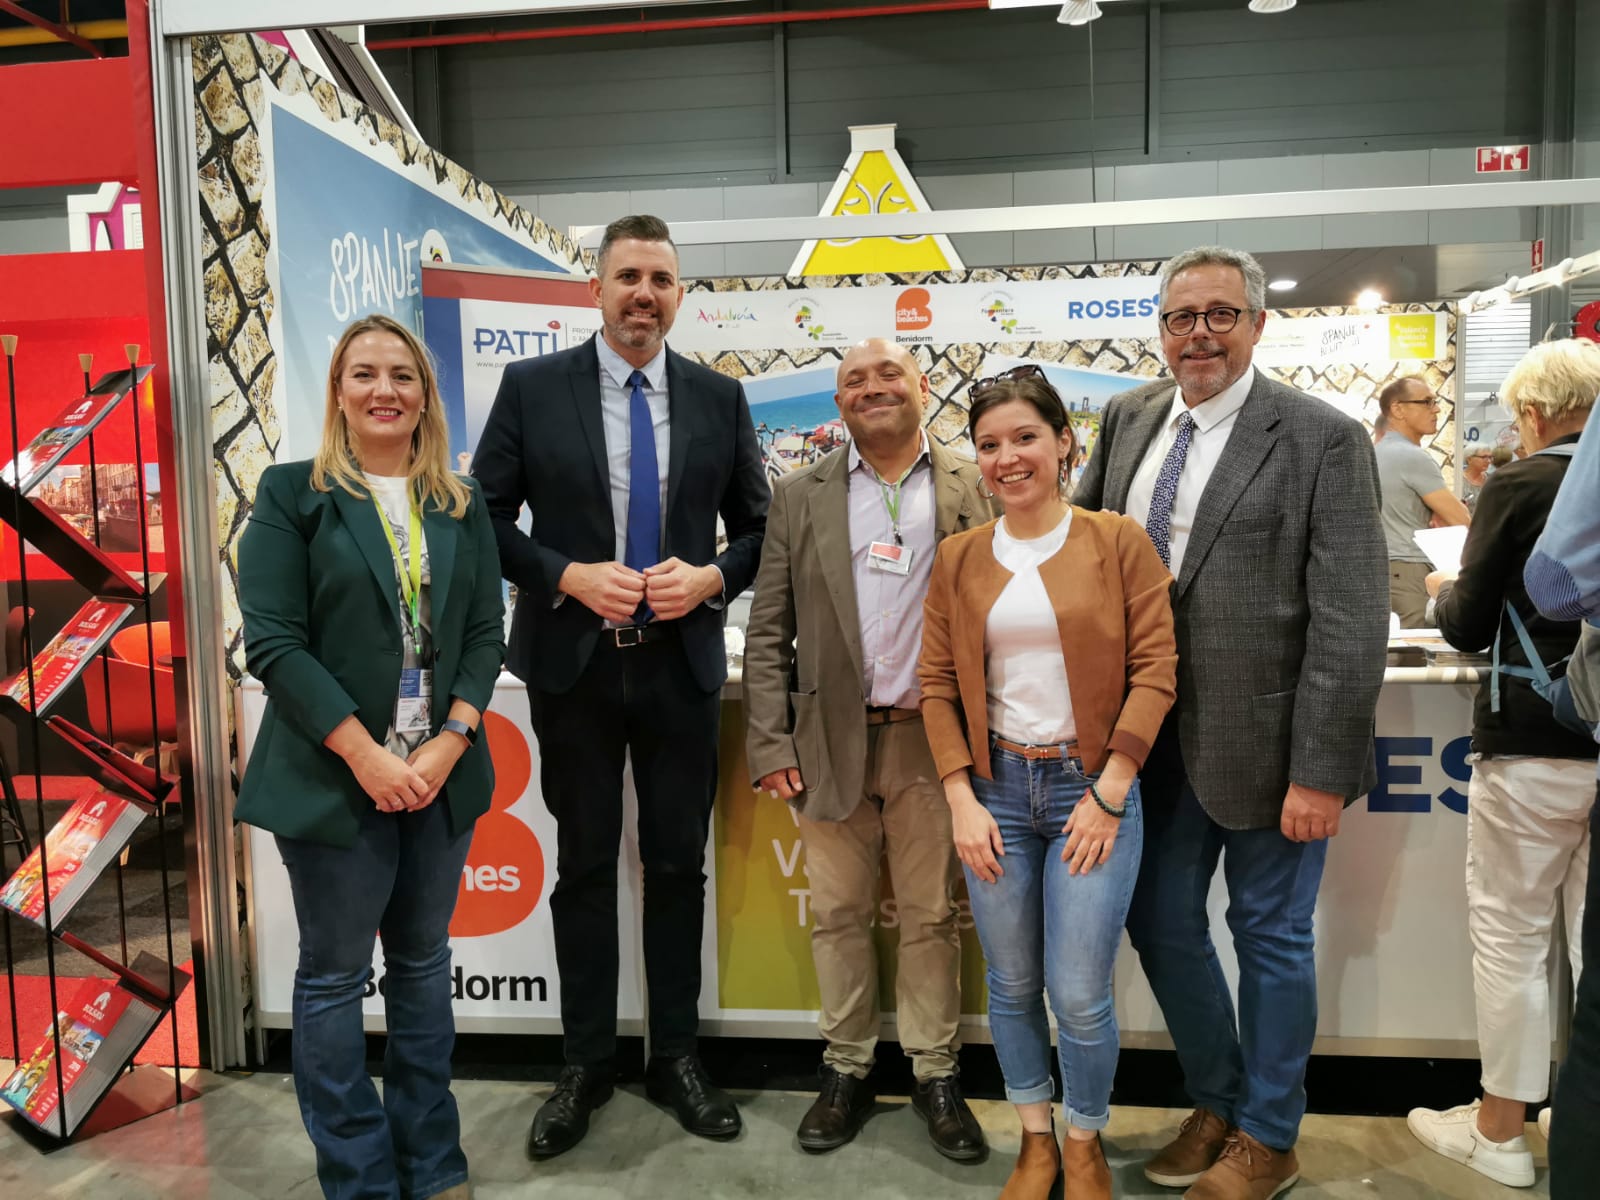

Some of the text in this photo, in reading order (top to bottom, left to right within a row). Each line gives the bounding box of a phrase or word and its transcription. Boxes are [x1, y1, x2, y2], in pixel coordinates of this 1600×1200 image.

[329, 227, 419, 322] SPANJE
[1068, 299, 1154, 320] ROSES
[895, 335, 933, 343] Benidorm
